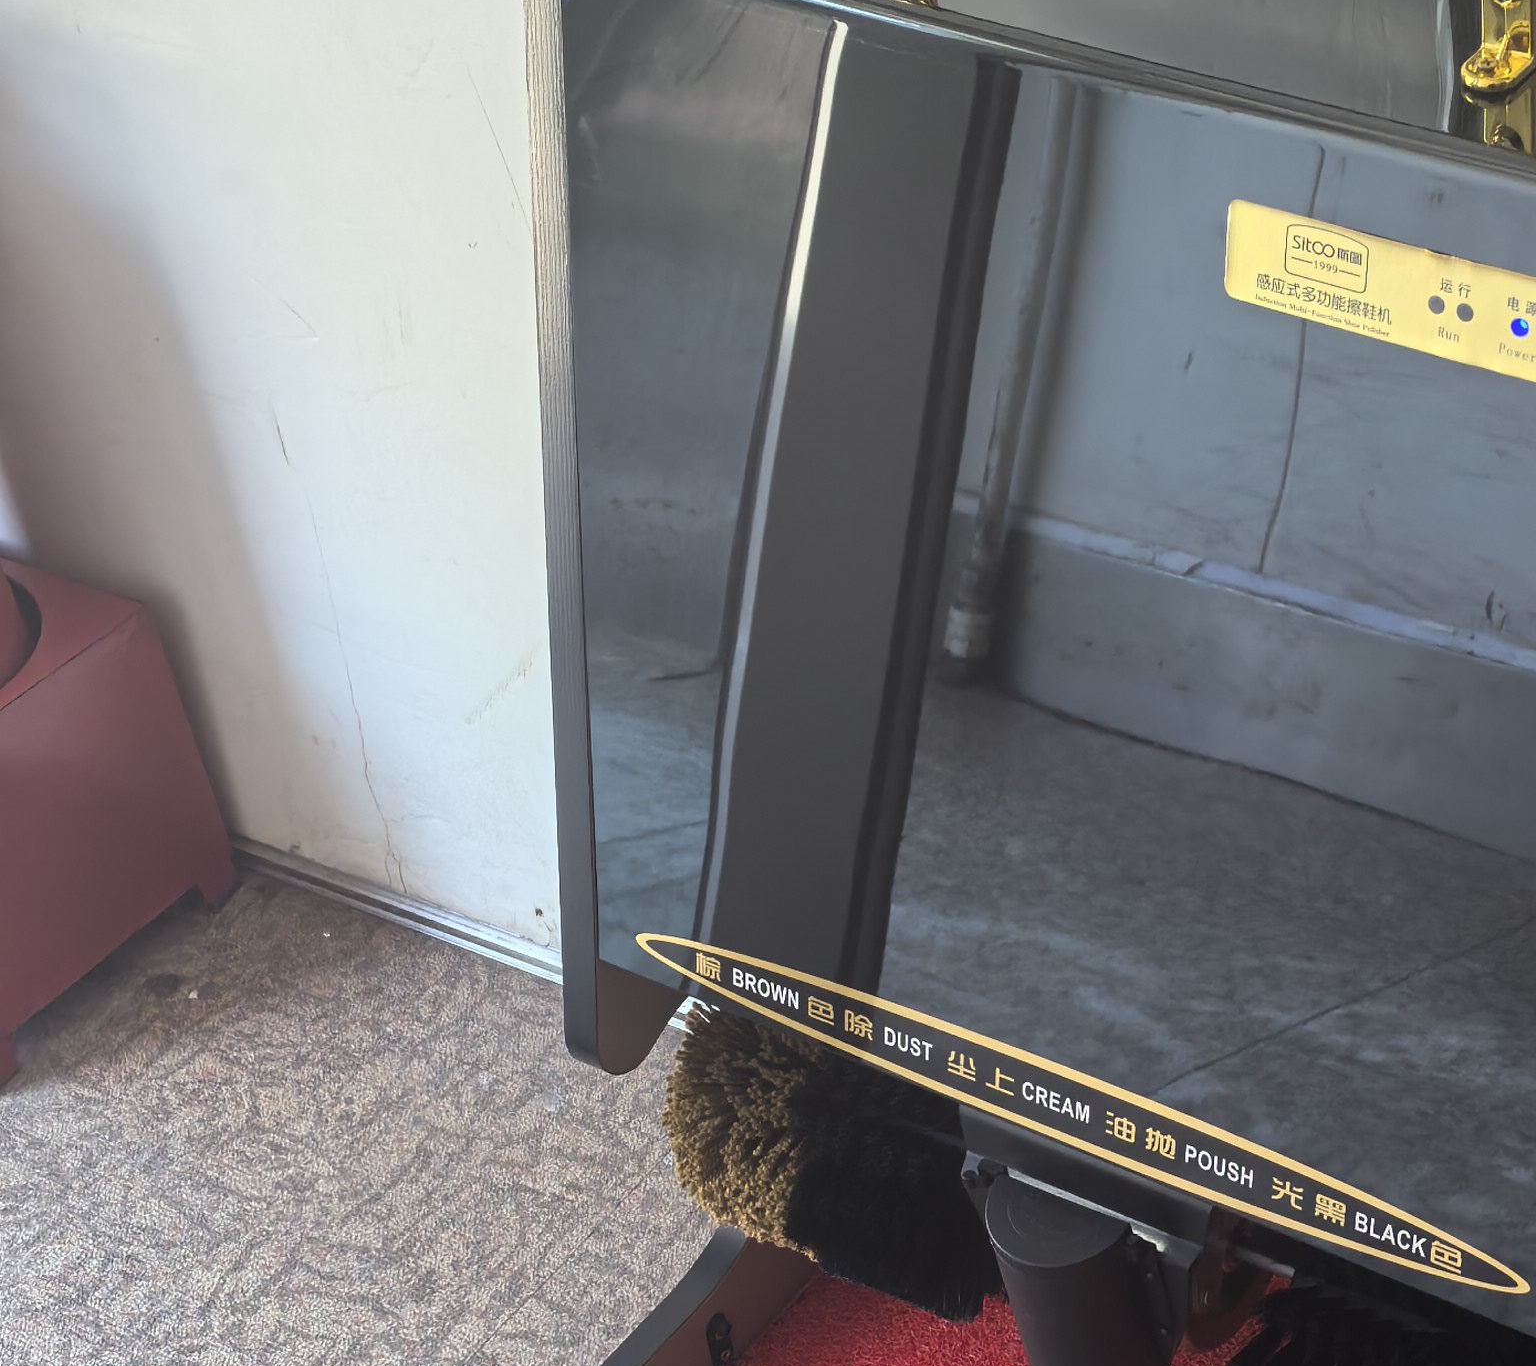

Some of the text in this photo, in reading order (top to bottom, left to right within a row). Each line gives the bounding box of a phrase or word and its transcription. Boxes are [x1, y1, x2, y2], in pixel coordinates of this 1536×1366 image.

[1313, 260, 1339, 274] 1999
[1440, 277, 1471, 299] 运行
[1256, 273, 1392, 326] 感应式多功能擦鞋机
[1437, 326, 1460, 343] Run
[1498, 342, 1536, 363] Power
[696, 952, 722, 983] 棕
[732, 968, 799, 1010] BROWN
[807, 995, 834, 1026] 色
[844, 1009, 874, 1041] 除
[884, 1027, 933, 1062] DUST
[947, 1050, 976, 1082] 尘
[985, 1067, 1015, 1096] 上
[1021, 1081, 1091, 1125] CREAM
[1105, 1110, 1136, 1143] 油
[1271, 1176, 1304, 1211] 光
[1354, 1211, 1427, 1257] BLACK
[1429, 1240, 1462, 1274] 色
